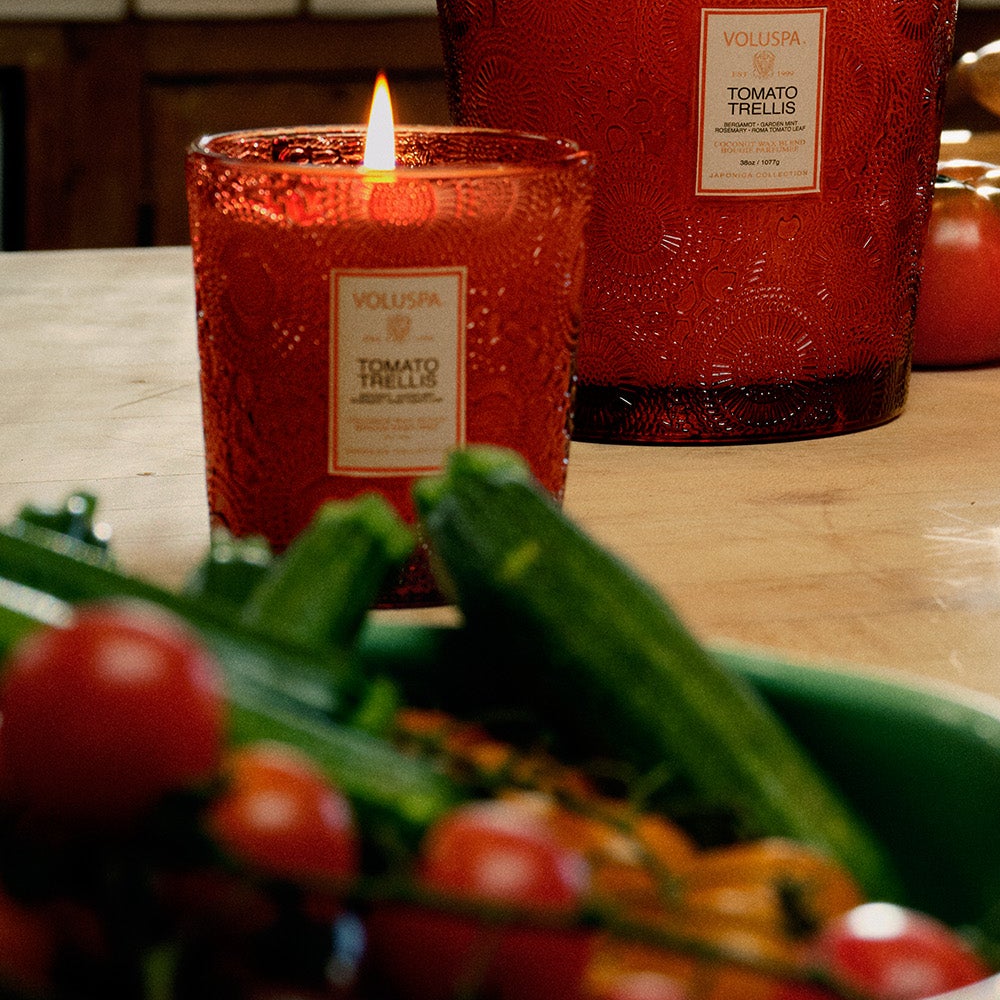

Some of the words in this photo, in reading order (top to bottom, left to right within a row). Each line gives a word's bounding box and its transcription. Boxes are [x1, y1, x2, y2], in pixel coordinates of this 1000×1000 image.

[727, 86, 798, 100] TOMATO
[728, 101, 796, 115] TRELLIS
[755, 170, 809, 179] COLLECTION
[357, 357, 440, 372] TOMATO
[358, 372, 438, 388] TRELLIS
